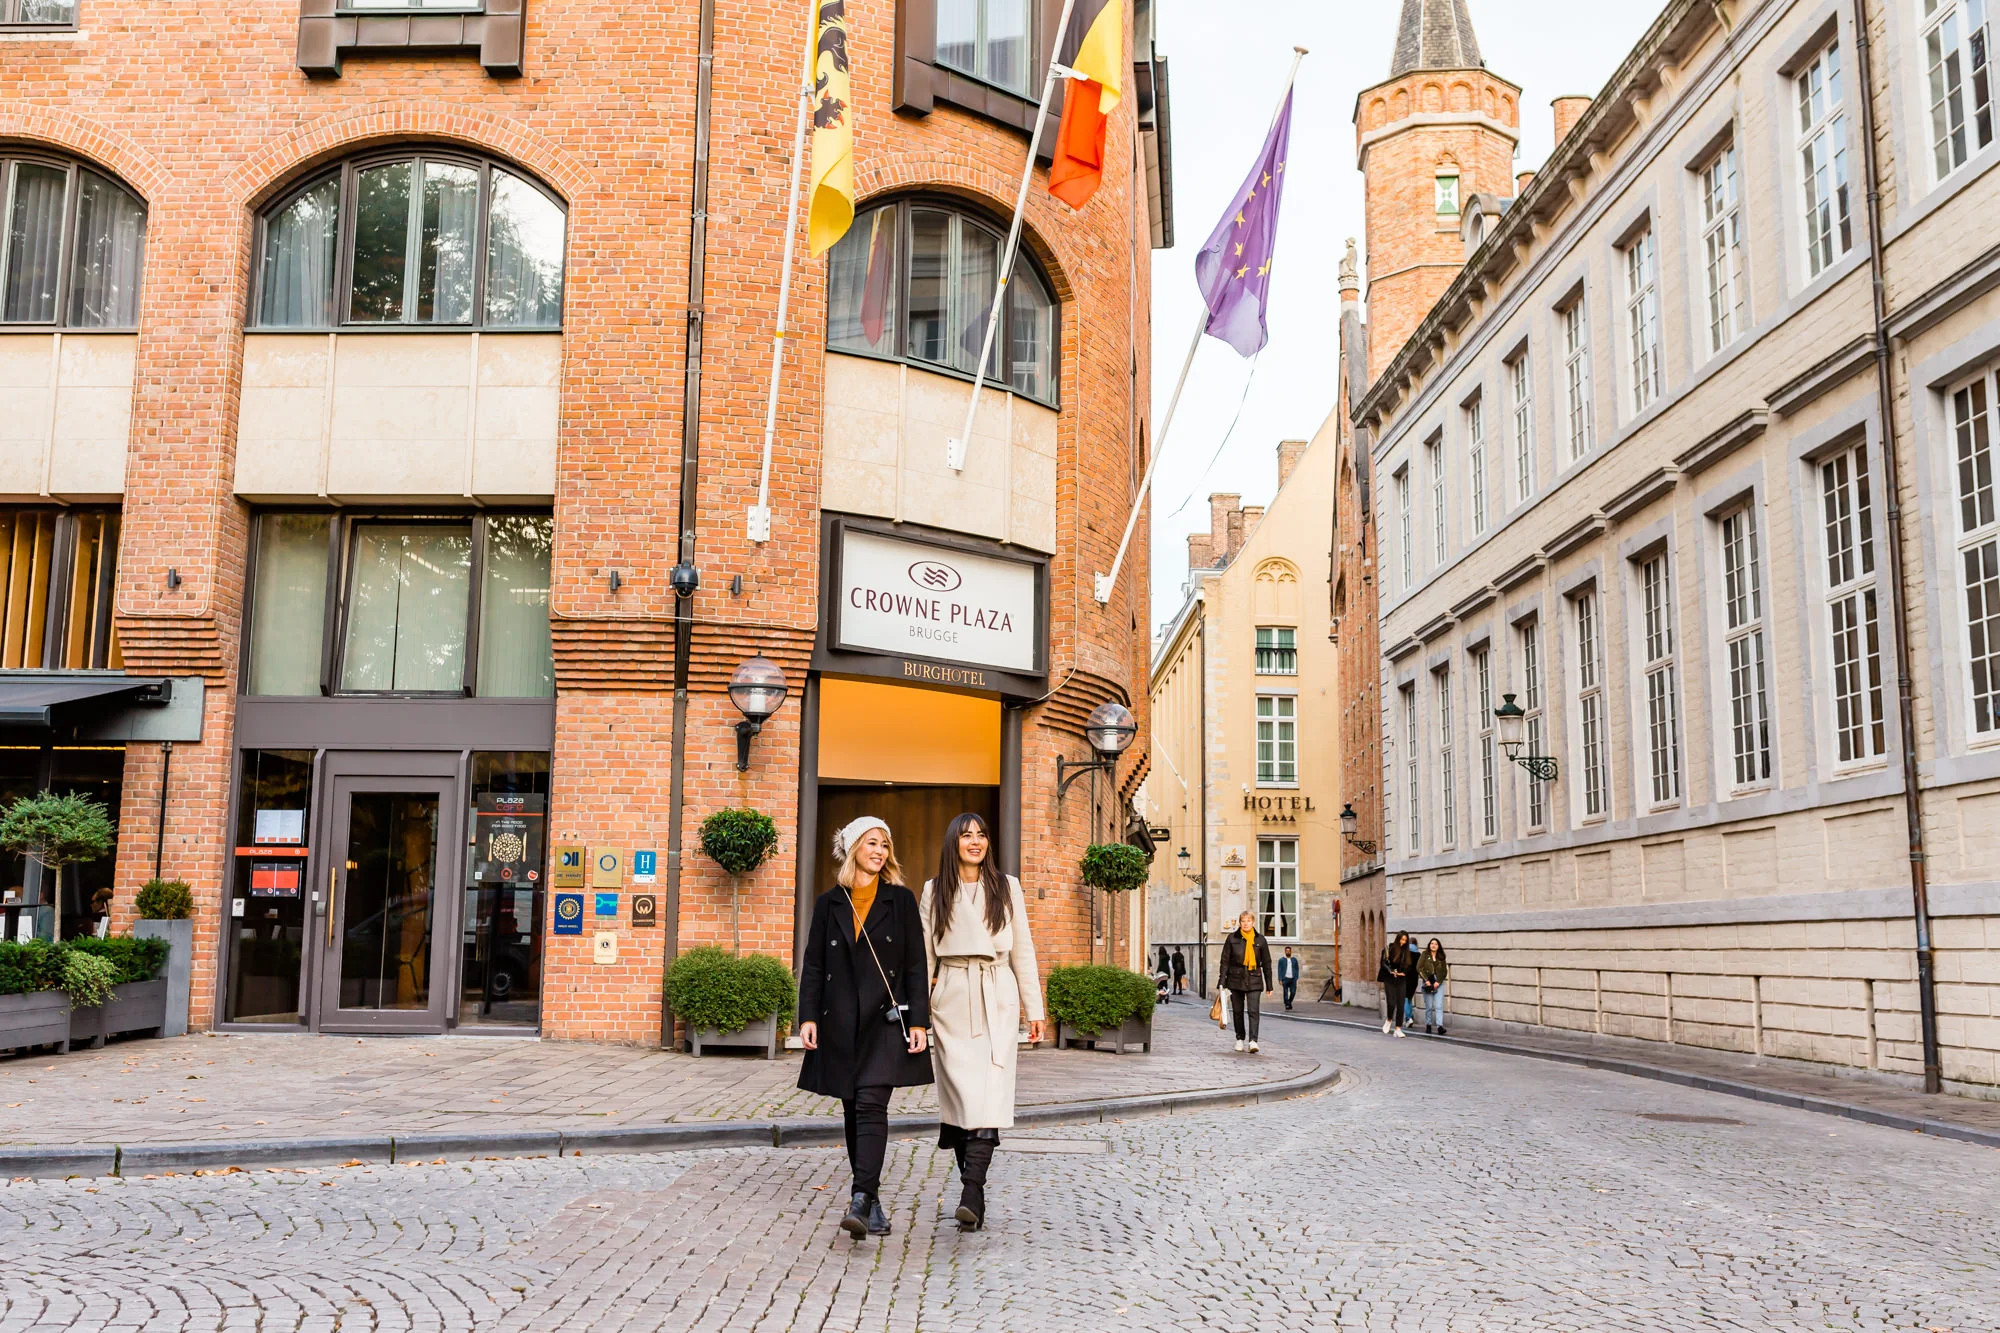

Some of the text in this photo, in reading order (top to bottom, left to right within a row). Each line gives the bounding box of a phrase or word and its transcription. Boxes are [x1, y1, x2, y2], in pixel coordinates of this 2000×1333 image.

[850, 587, 1013, 633] CROWNE PLAZA
[909, 625, 959, 644] BRUGGE
[903, 661, 986, 687] BURGHOTEL
[1244, 796, 1316, 811] HOTEL
[641, 854, 651, 869] H
